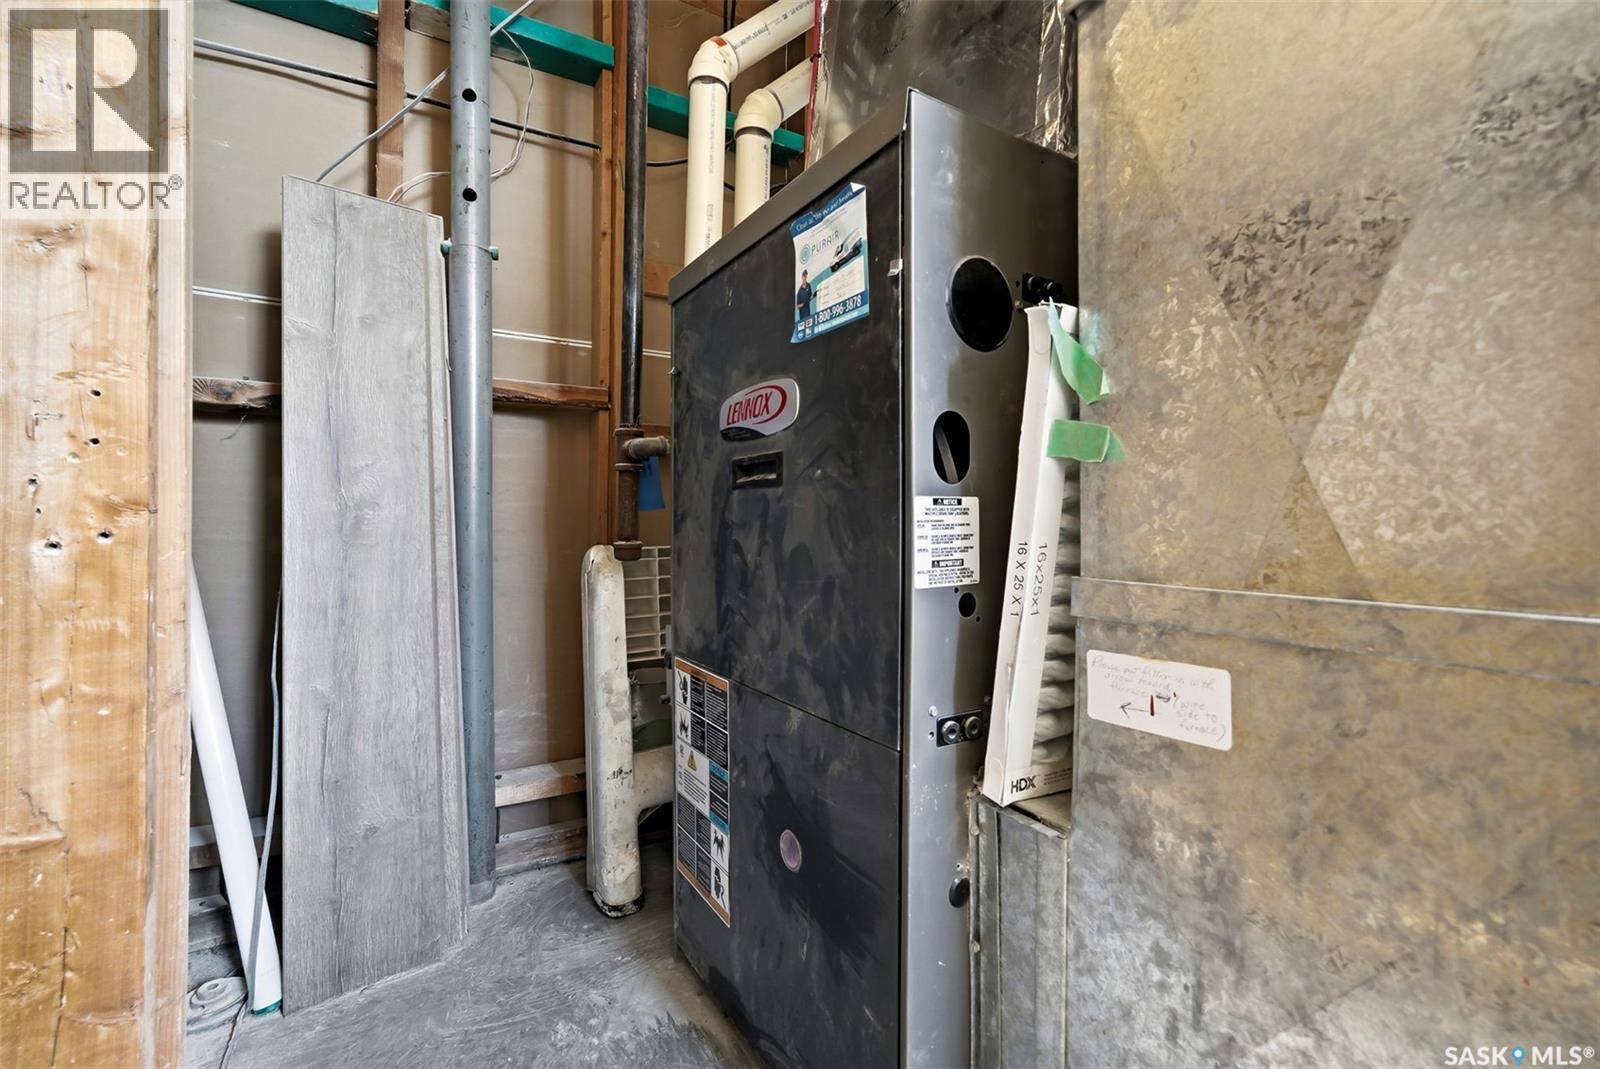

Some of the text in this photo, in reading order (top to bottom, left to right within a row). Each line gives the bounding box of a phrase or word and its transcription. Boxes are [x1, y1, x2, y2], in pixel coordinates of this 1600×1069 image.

[726, 391, 773, 426] LENNOX
[1017, 541, 1028, 556] 16
[1013, 575, 1025, 591] 25
[1030, 542, 1048, 616] 16x25x1
[1011, 776, 1036, 794] HDX
